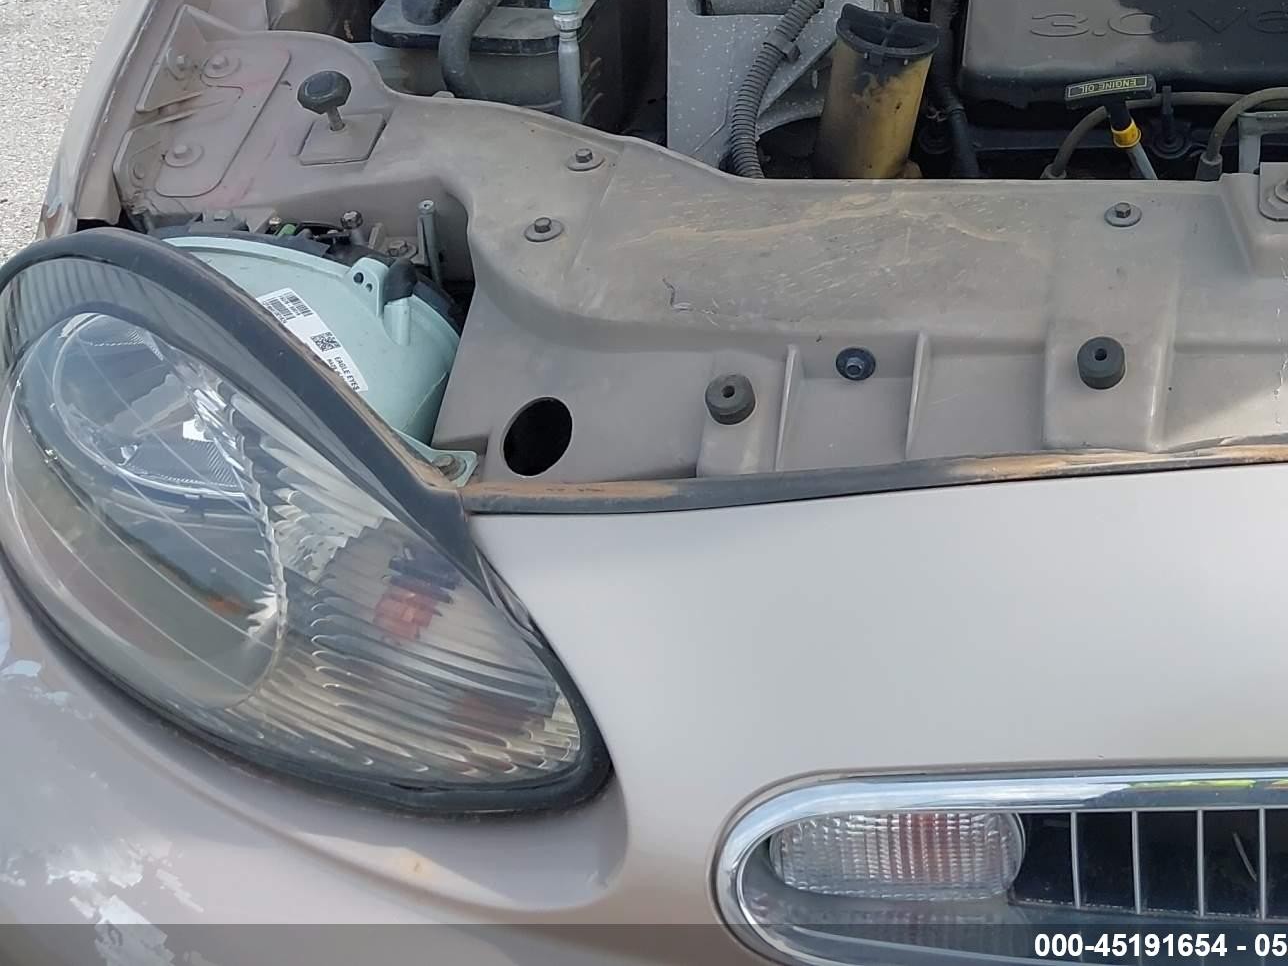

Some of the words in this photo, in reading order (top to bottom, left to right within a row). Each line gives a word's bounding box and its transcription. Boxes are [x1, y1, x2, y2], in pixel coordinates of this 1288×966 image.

[1029, 12, 1171, 38] 3.0
[334, 356, 350, 377] EAGLE
[346, 374, 361, 391] EYES
